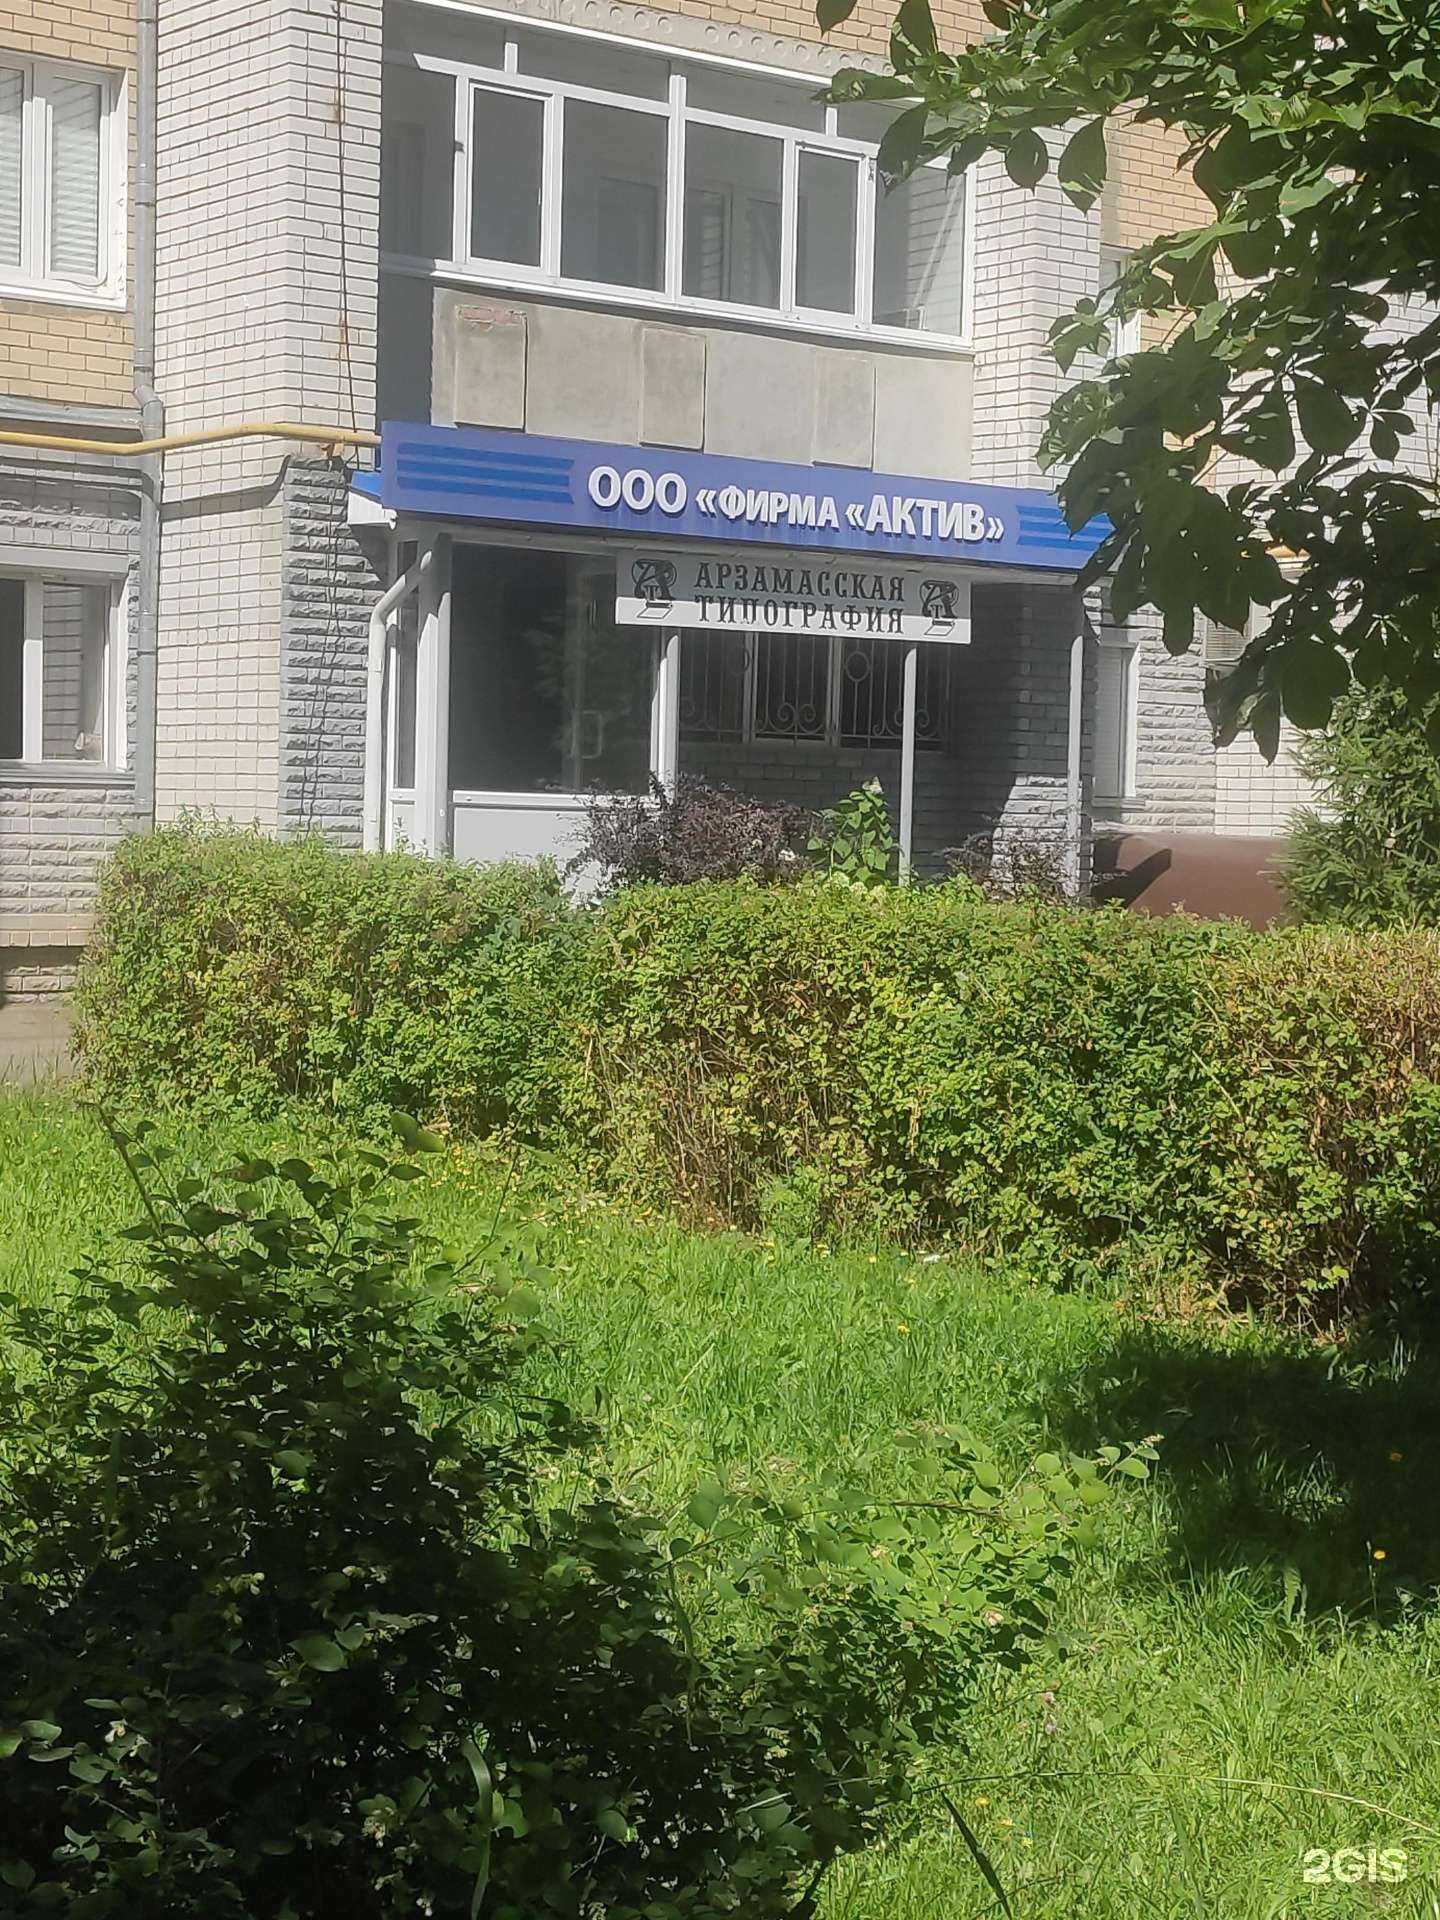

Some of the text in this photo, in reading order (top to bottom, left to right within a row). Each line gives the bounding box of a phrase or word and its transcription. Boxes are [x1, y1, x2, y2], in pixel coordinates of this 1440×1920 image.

[588, 466, 1005, 542] ООО «ФИРМА «АКТИВ»
[693, 561, 905, 602] АРЗАМАССКАЯ
[694, 594, 905, 634] ТИПОГРАФИЯ
